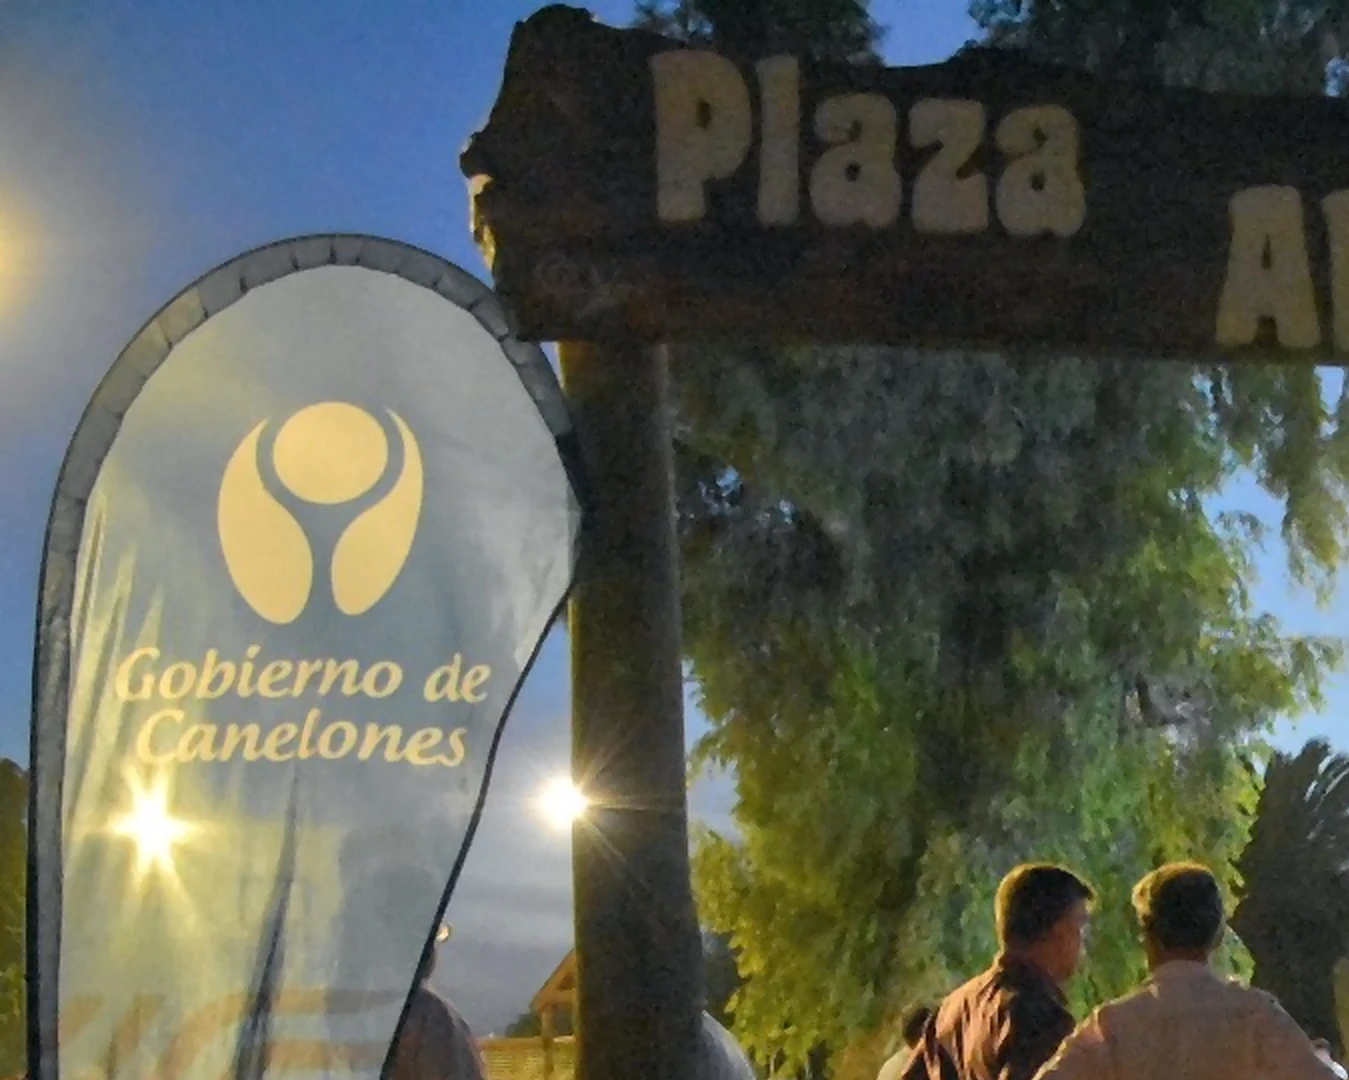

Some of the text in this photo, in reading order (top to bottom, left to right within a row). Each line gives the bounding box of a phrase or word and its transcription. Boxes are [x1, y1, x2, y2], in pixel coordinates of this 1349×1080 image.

[649, 49, 1087, 238] Plaza
[114, 645, 492, 703] Gobierno de
[136, 707, 468, 767] Canelones
